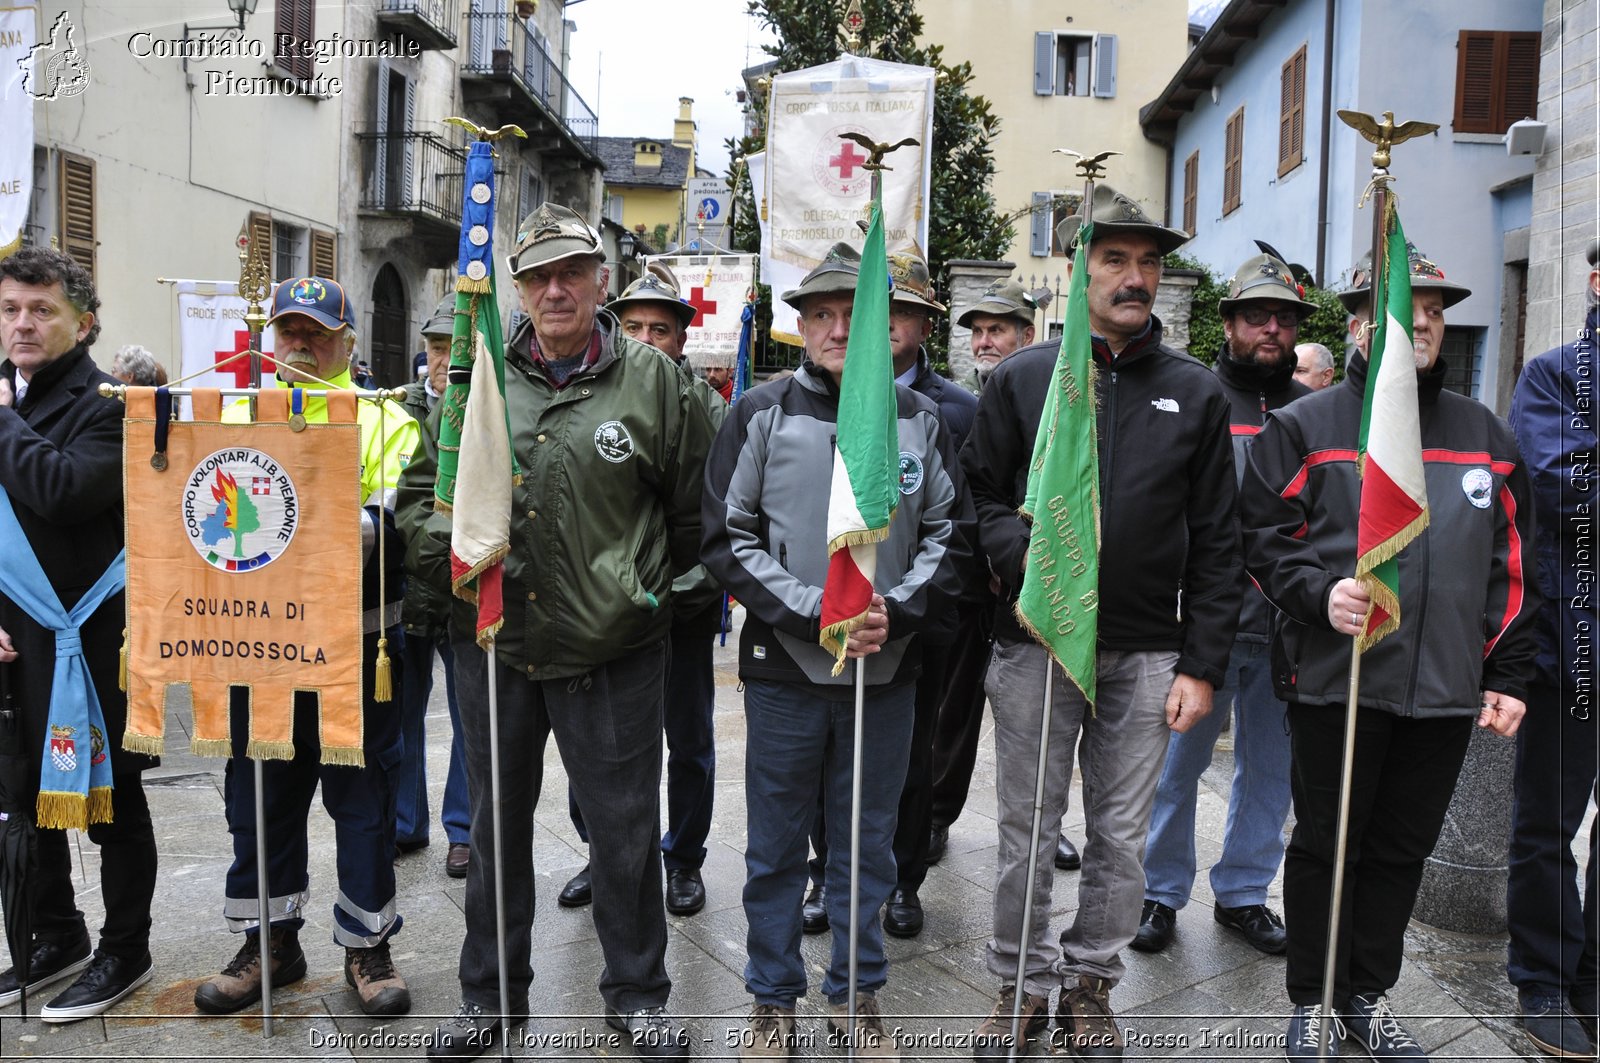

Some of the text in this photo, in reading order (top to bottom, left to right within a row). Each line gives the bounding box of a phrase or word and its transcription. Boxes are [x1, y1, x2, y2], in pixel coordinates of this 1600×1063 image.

[866, 100, 915, 113] ITALIANA
[781, 227, 844, 241] PREMOSELLO
[187, 307, 215, 320] CROCE
[185, 451, 296, 543] CORPO VOLONTARI A.I.B. PIEMONTE
[1047, 494, 1087, 578] GRUPPO
[184, 598, 304, 621] SQUADRA DI
[159, 639, 327, 665] DOMODOSSOLA
